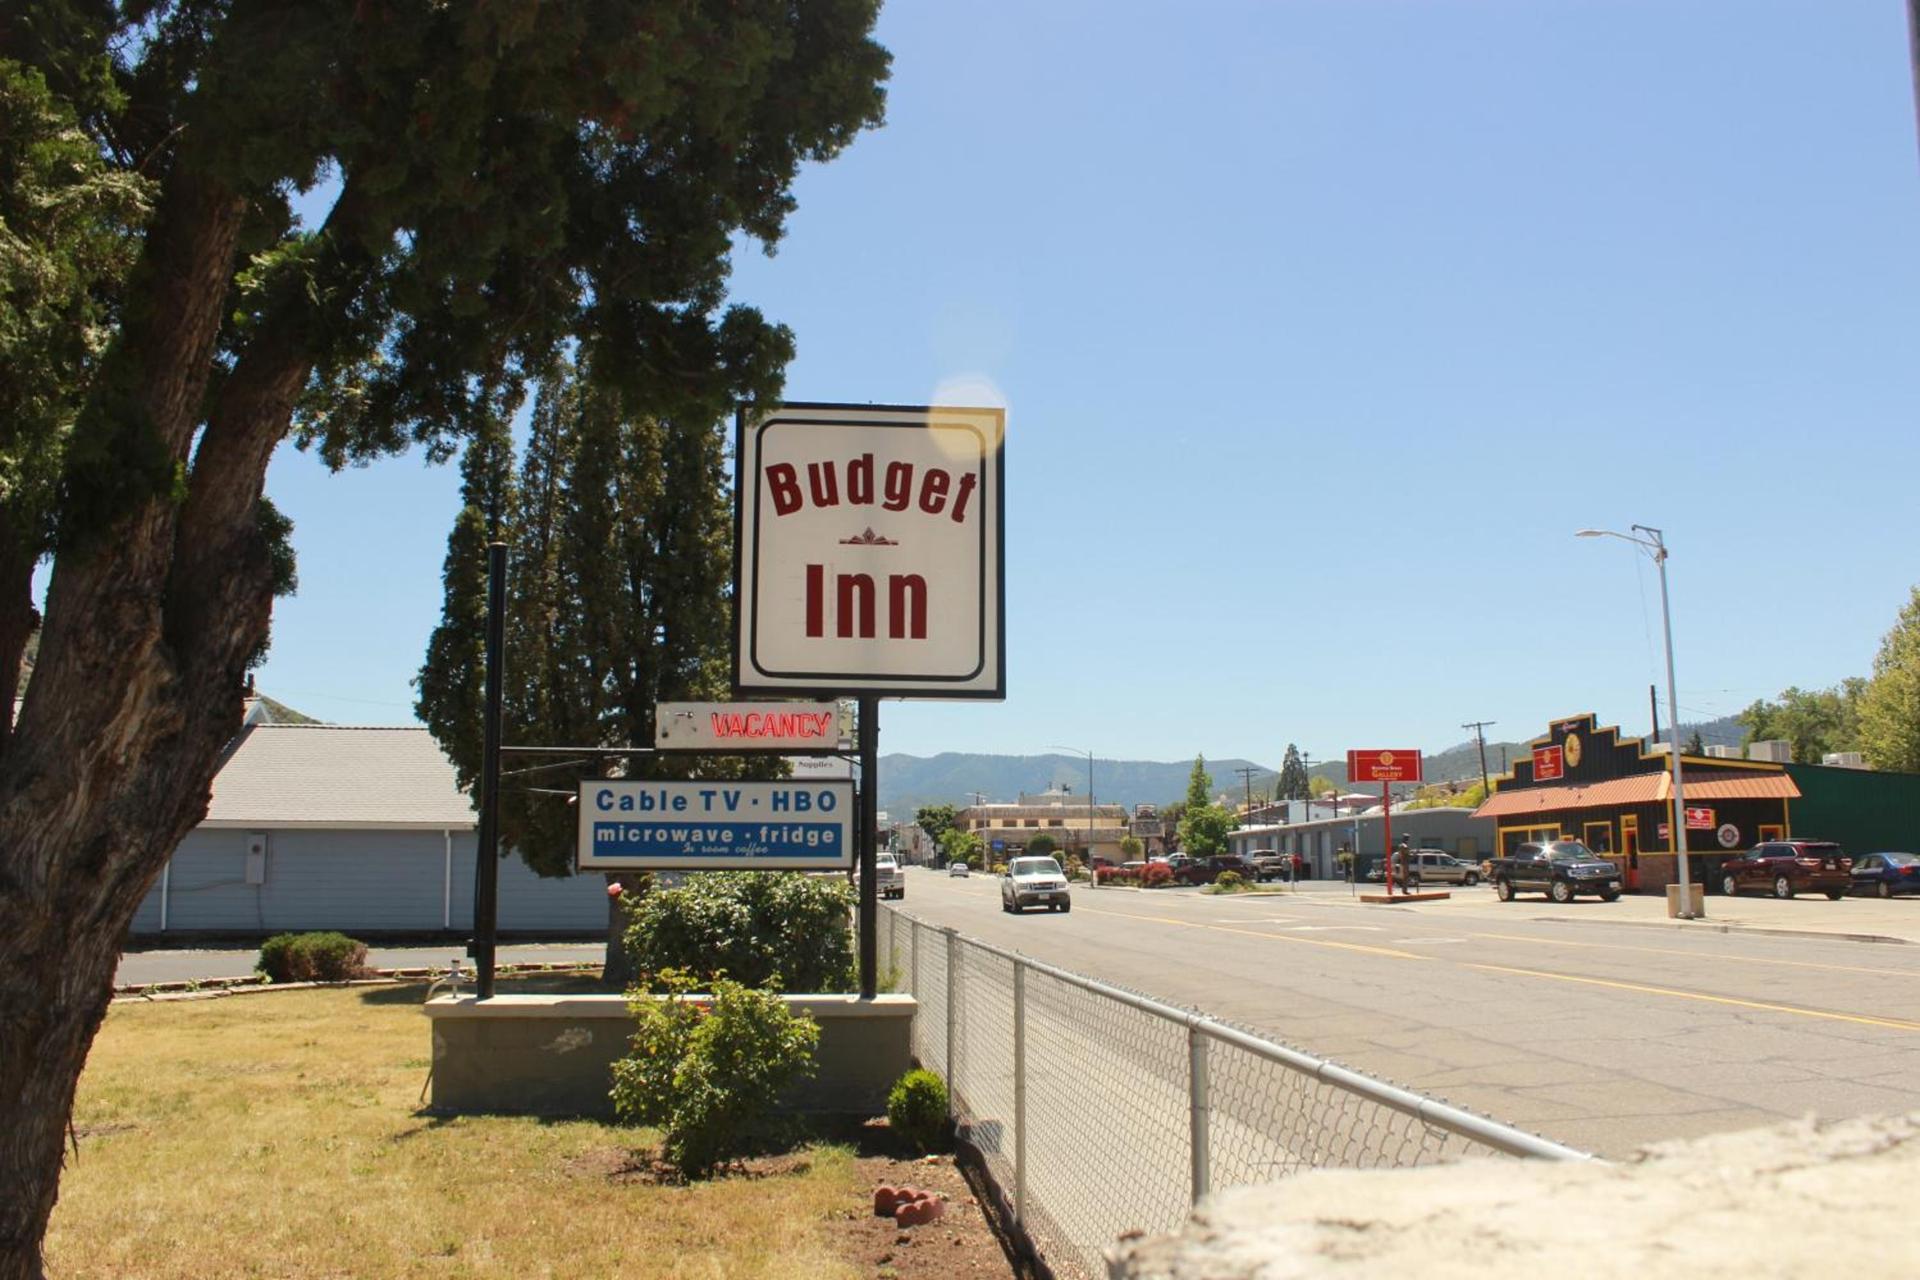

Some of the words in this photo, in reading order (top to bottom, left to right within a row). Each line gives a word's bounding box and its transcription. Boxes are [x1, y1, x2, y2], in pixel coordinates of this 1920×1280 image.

[765, 453, 977, 523] Budget
[806, 564, 928, 639] Inn
[711, 712, 831, 737] VACANCY
[596, 789, 688, 811] Cable
[699, 790, 741, 811] TV
[772, 791, 837, 812] HBO
[597, 825, 734, 842] microwave
[759, 825, 835, 847] fridge
